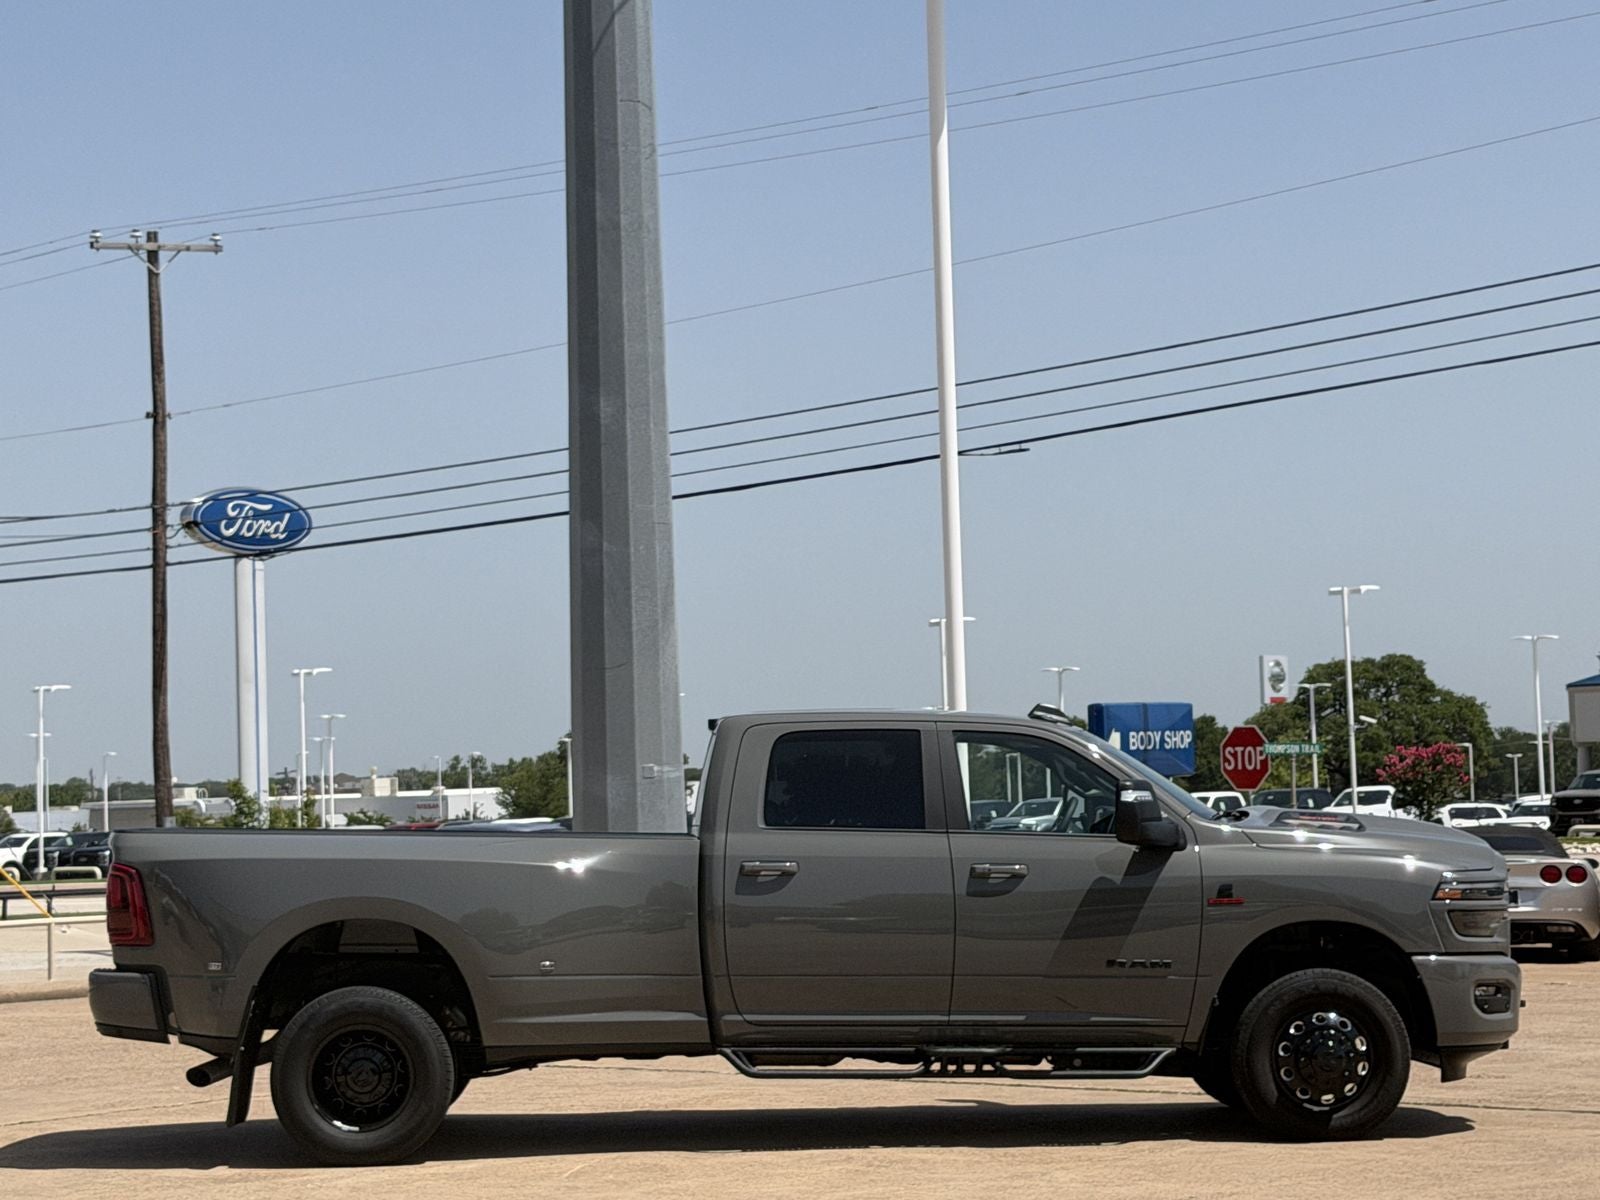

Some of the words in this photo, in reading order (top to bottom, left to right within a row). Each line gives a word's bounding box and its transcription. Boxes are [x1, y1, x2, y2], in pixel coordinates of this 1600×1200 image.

[220, 500, 290, 539] Ford
[1128, 731, 1162, 751] BODY
[1164, 730, 1193, 750] SHOP
[1224, 746, 1266, 770] STOP
[1105, 959, 1173, 969] RAM
